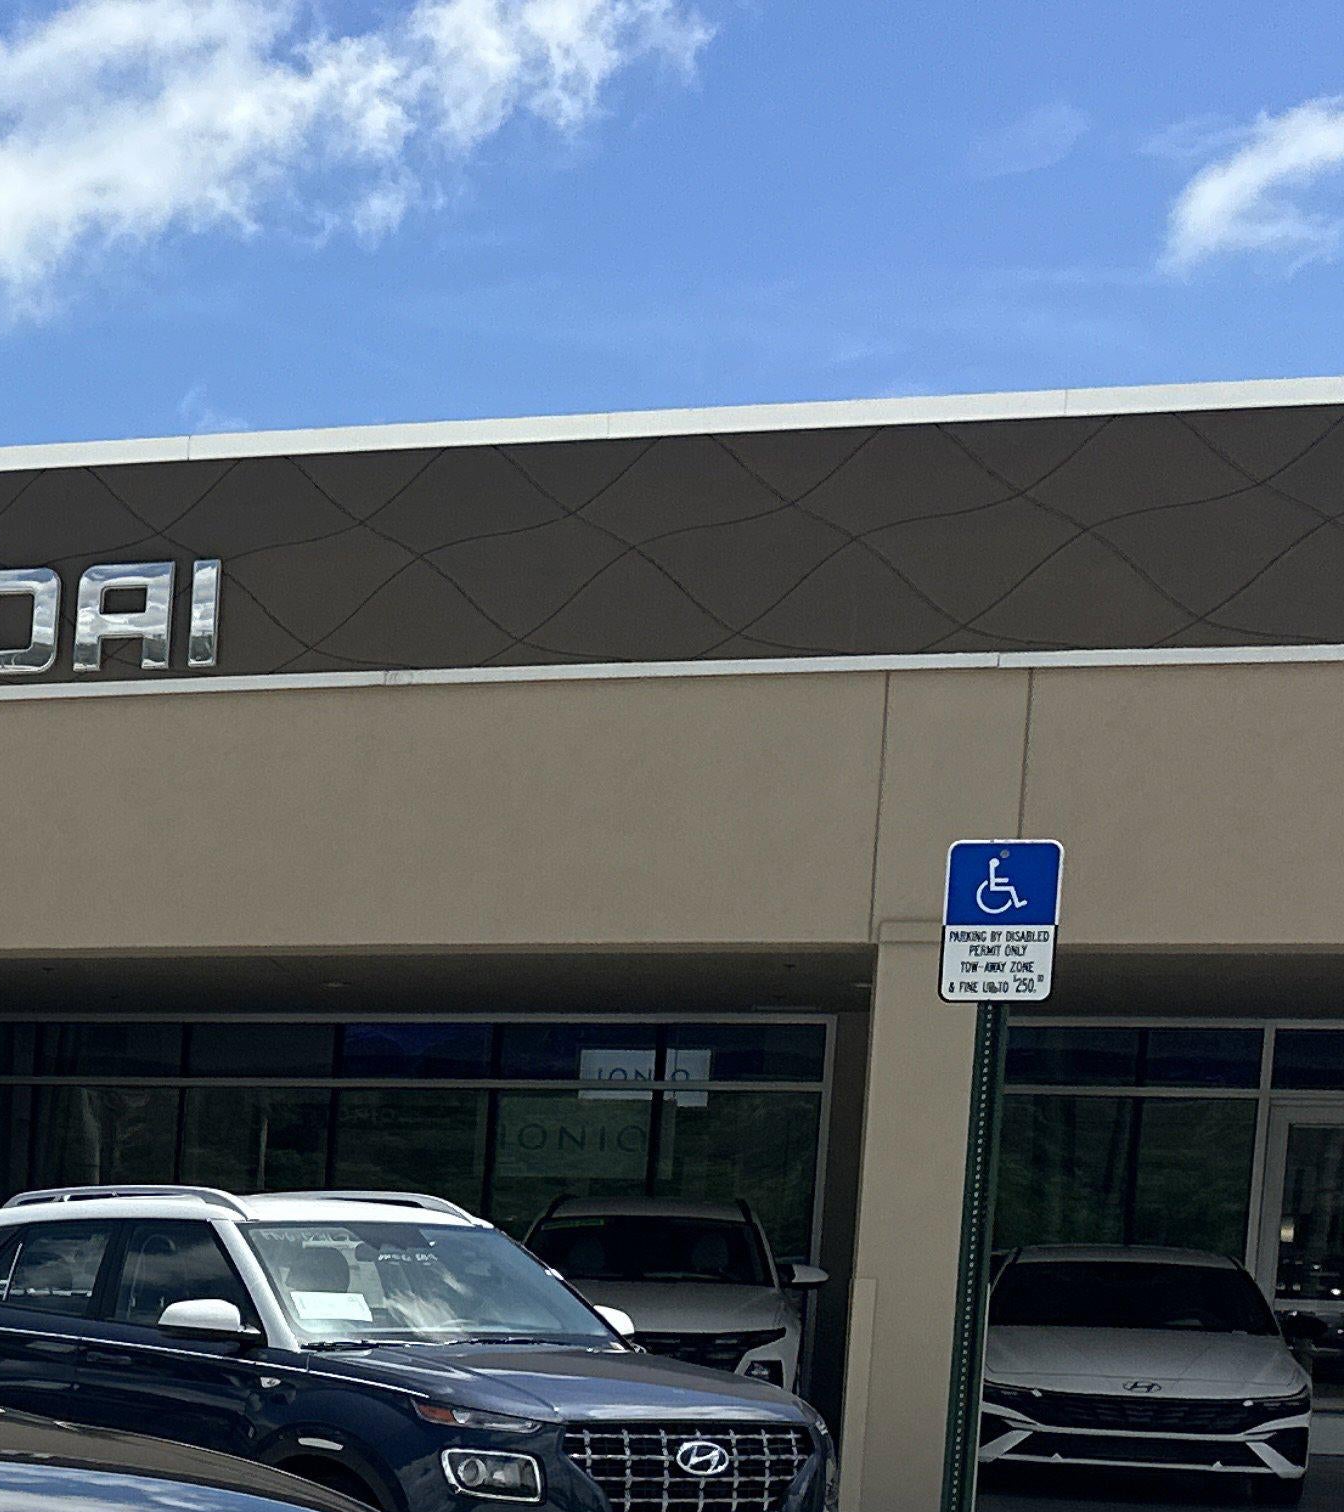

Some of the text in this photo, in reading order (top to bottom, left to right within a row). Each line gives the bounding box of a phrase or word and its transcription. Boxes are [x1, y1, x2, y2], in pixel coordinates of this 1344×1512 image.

[949, 930, 1050, 942] PARKING BY DISABLED
[968, 944, 1028, 957] PERMIT ONLY
[960, 961, 1034, 973] TOW-AWAY ZONE
[948, 981, 955, 993] &
[959, 981, 979, 993] FINE
